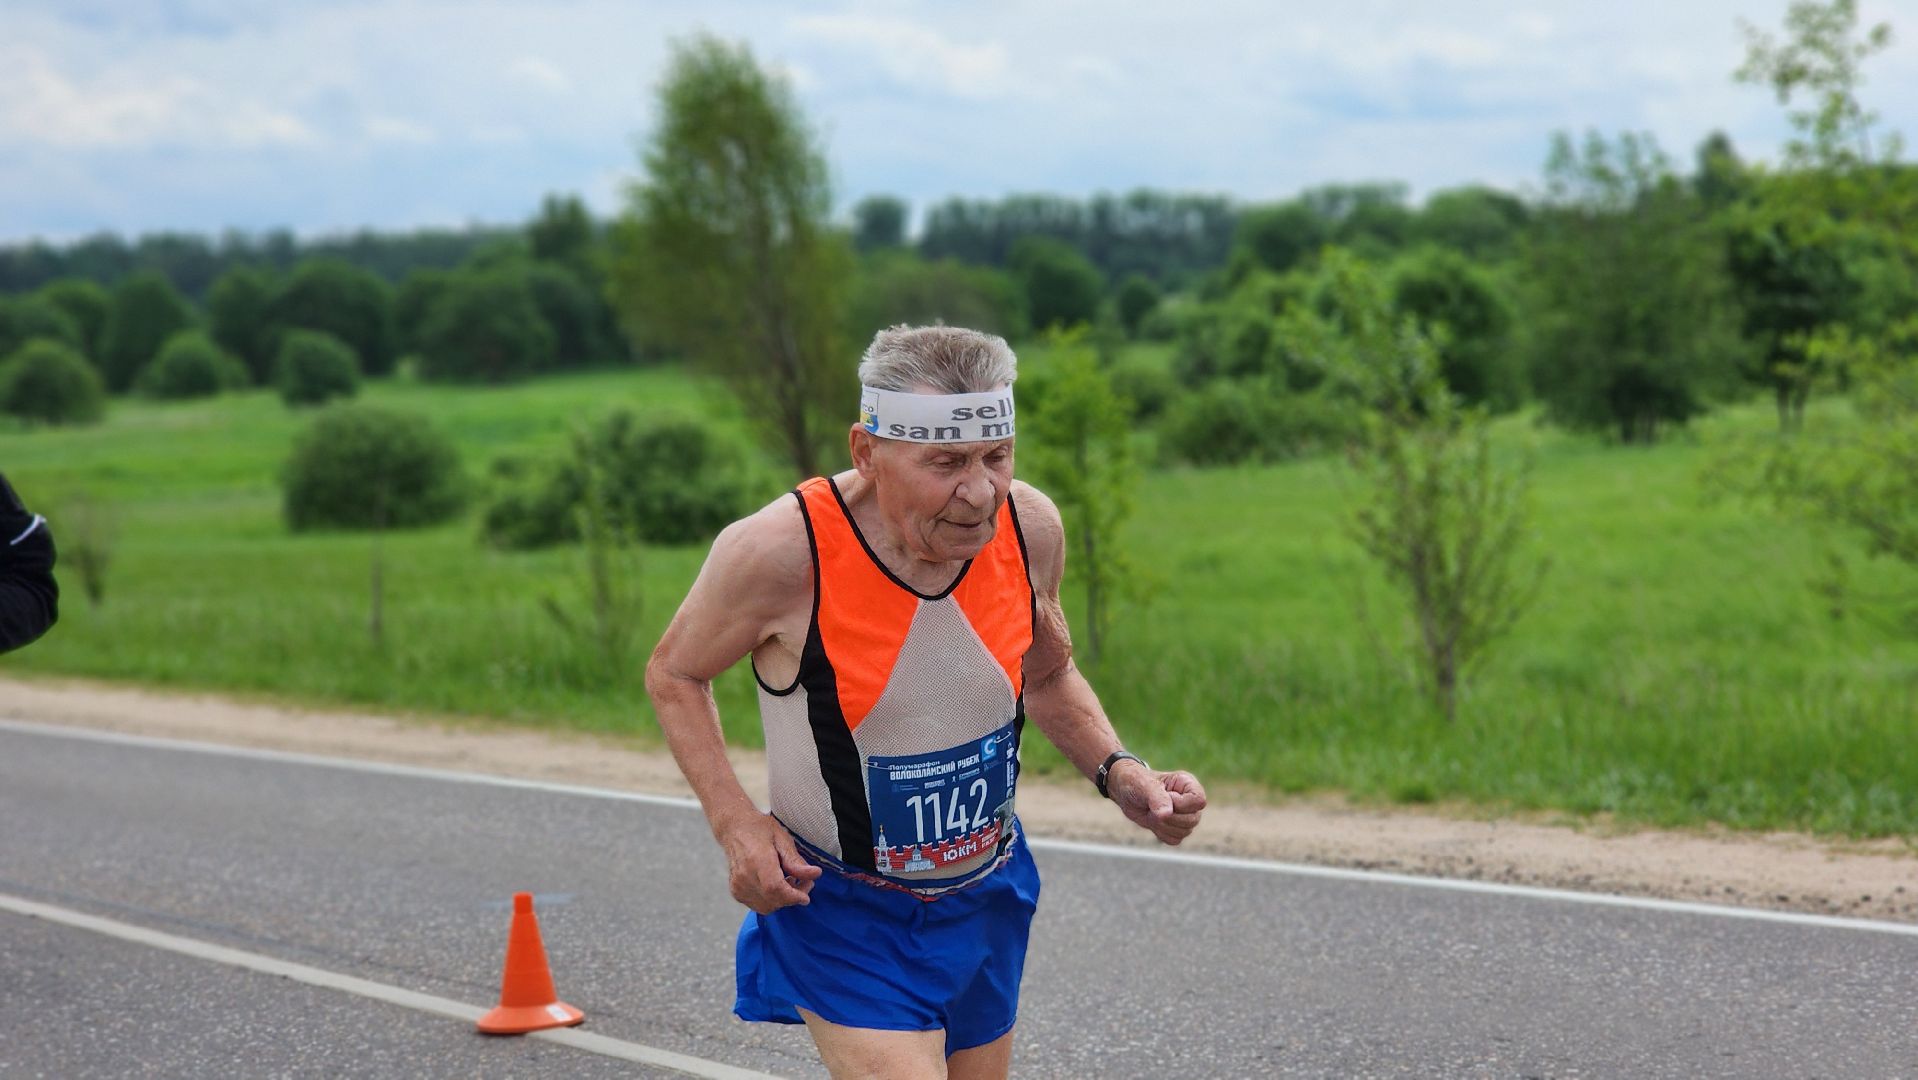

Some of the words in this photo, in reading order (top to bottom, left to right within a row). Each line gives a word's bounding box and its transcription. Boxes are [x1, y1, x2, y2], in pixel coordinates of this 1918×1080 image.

[888, 423, 962, 440] san
[981, 421, 1014, 438] m
[889, 761, 956, 781] ВОЛОКОЛАМСКИЙ
[957, 753, 980, 770] РУБЕЖ
[906, 778, 989, 843] 1142
